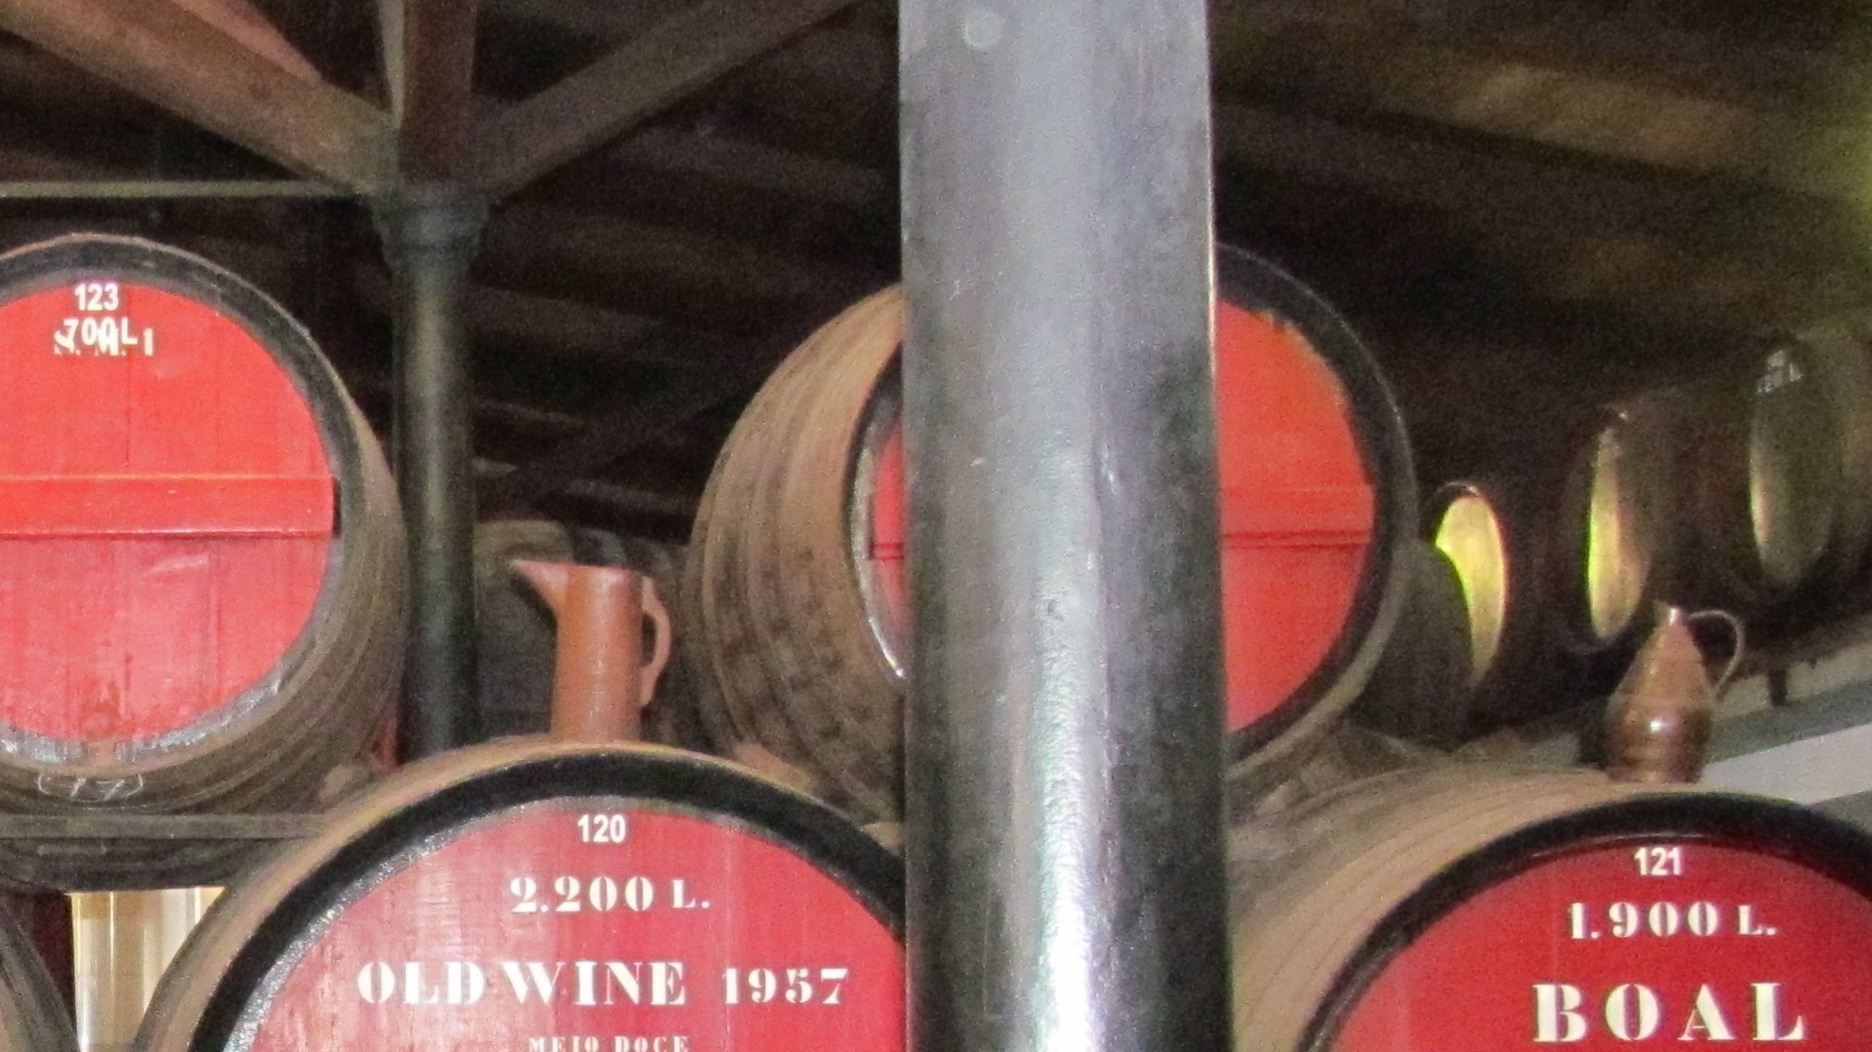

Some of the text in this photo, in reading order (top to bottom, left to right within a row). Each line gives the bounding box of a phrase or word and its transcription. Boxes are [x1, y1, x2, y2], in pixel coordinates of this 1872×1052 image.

[74, 283, 119, 311] 123
[577, 814, 626, 843] 120
[1633, 846, 1682, 876] 121
[509, 875, 654, 913] 2.200
[1568, 901, 1720, 939] 1.900
[357, 961, 849, 1006] OLD WINE 1957
[1531, 982, 1808, 1042] BOAL
